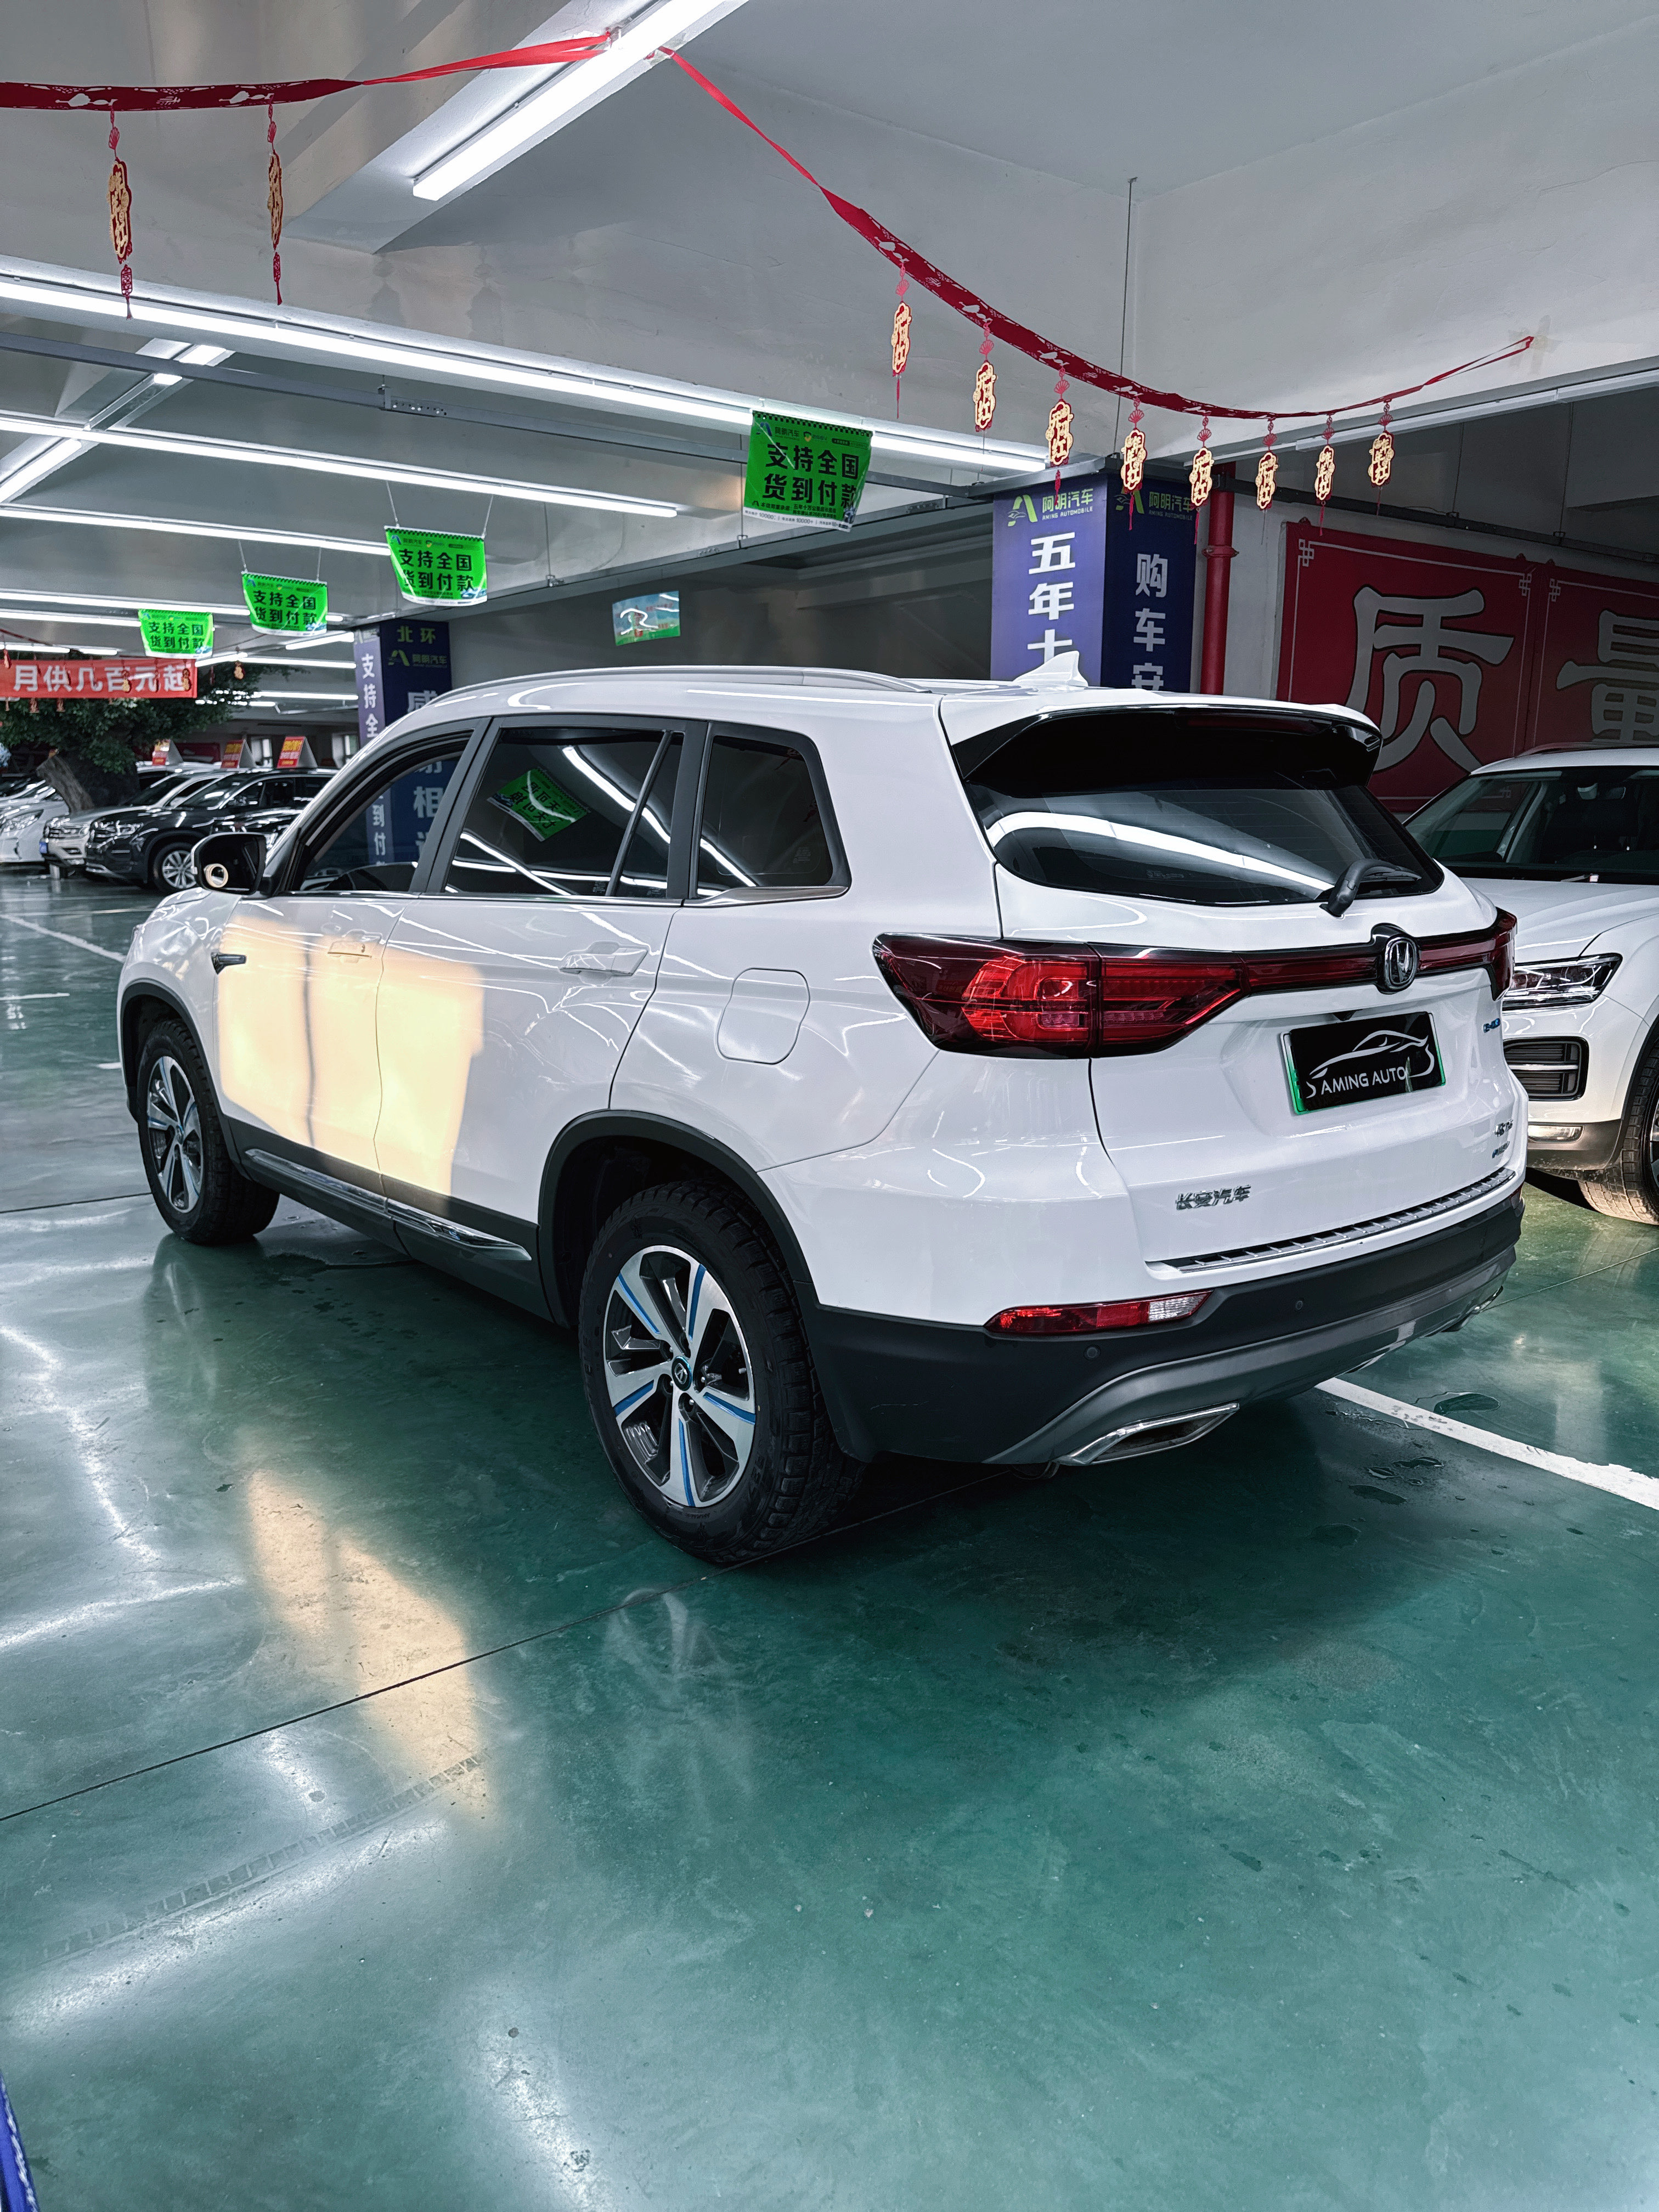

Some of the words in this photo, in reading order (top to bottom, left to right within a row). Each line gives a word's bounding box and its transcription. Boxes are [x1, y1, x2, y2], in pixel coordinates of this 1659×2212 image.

[765, 442, 859, 479] 支持全国
[762, 473, 856, 509] 货到付款
[1042, 488, 1093, 513] 阿明汽车
[1149, 491, 1192, 512] 阿明汽车
[1060, 506, 1093, 517] AUTOMOBILE
[399, 549, 472, 572] 支持全国
[403, 571, 474, 592] 货到付款
[253, 590, 316, 610] 支持全国
[1028, 532, 1075, 664] 五年十
[255, 607, 317, 625] 货到付款
[148, 621, 204, 636] 支持全国
[397, 625, 436, 645] 北环
[150, 635, 205, 650] 货到付款
[14, 664, 190, 692] 月供几百元起
[1344, 584, 1515, 774] 质
[361, 653, 379, 738] 支持全
[1321, 1073, 1369, 1096] AMING
[1372, 1066, 1408, 1086] AUTO
[1175, 1184, 1252, 1211] 长安汽车
